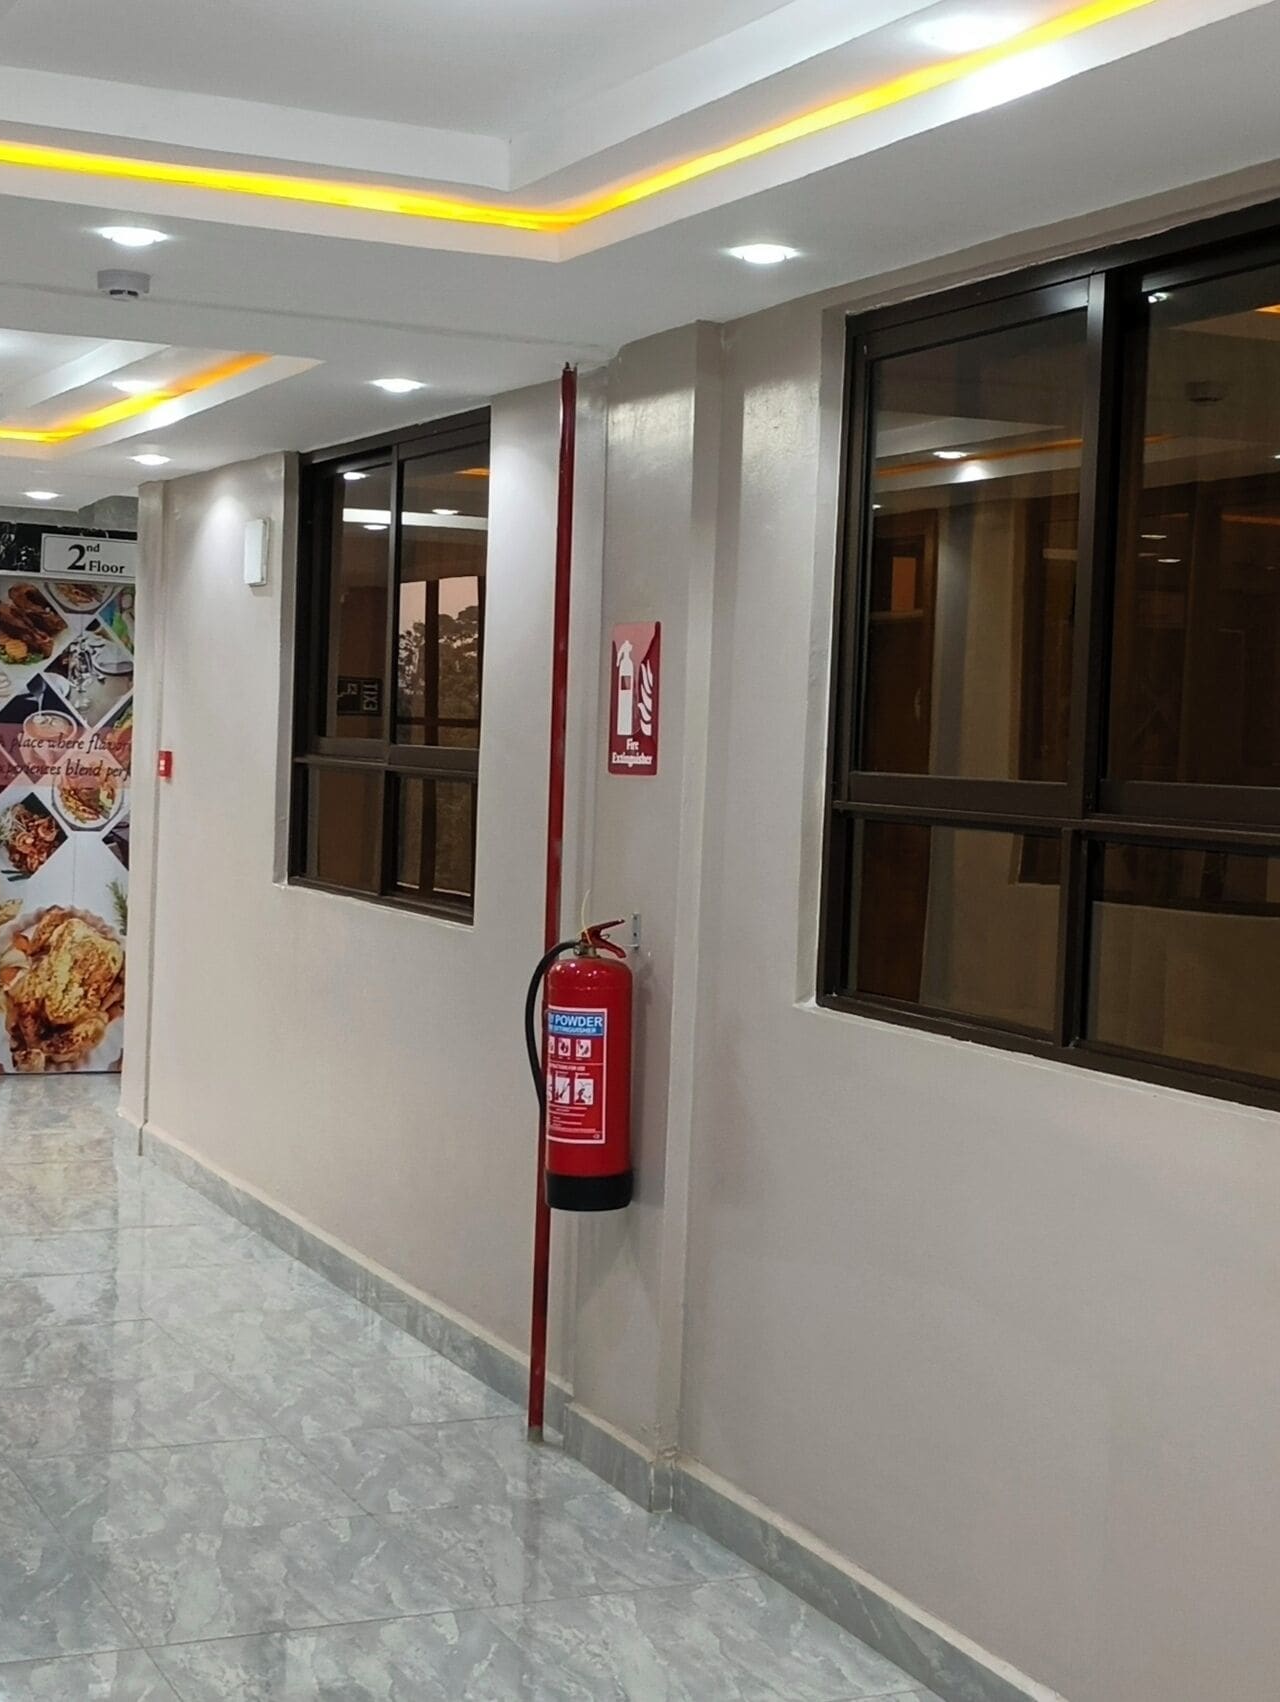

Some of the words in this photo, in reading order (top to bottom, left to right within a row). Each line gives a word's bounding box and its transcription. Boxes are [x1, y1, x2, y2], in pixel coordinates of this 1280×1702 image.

[67, 543, 100, 571] 2nd
[88, 560, 126, 574] Floor
[8, 731, 44, 753] place
[48, 731, 85, 750] where
[65, 758, 104, 777] blend
[555, 1014, 603, 1027] POWDER
